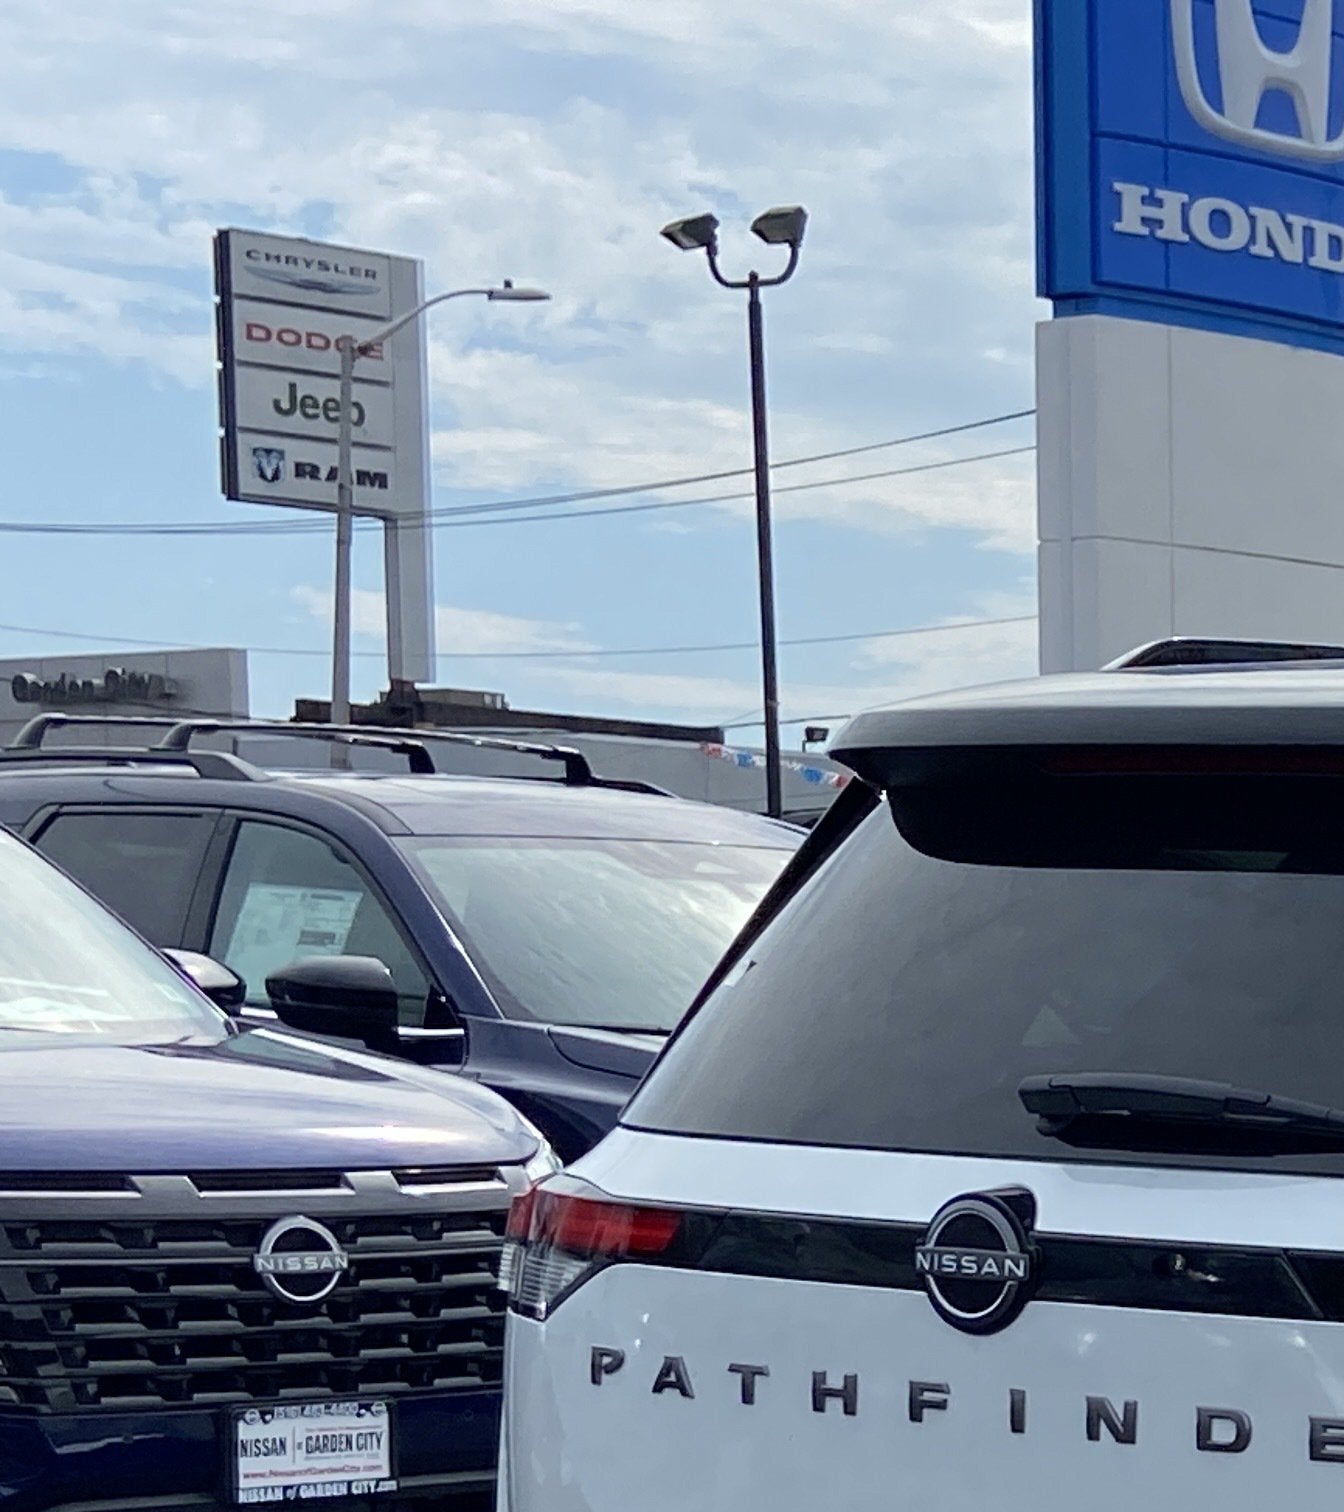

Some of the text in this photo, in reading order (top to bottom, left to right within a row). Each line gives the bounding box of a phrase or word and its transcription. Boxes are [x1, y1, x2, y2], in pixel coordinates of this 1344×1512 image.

[245, 249, 378, 281] CHRYSLER
[257, 1256, 348, 1272] NISSAN
[915, 1251, 1025, 1278] NISSAN
[240, 1431, 383, 1458] NISSAN GARDEN CITY
